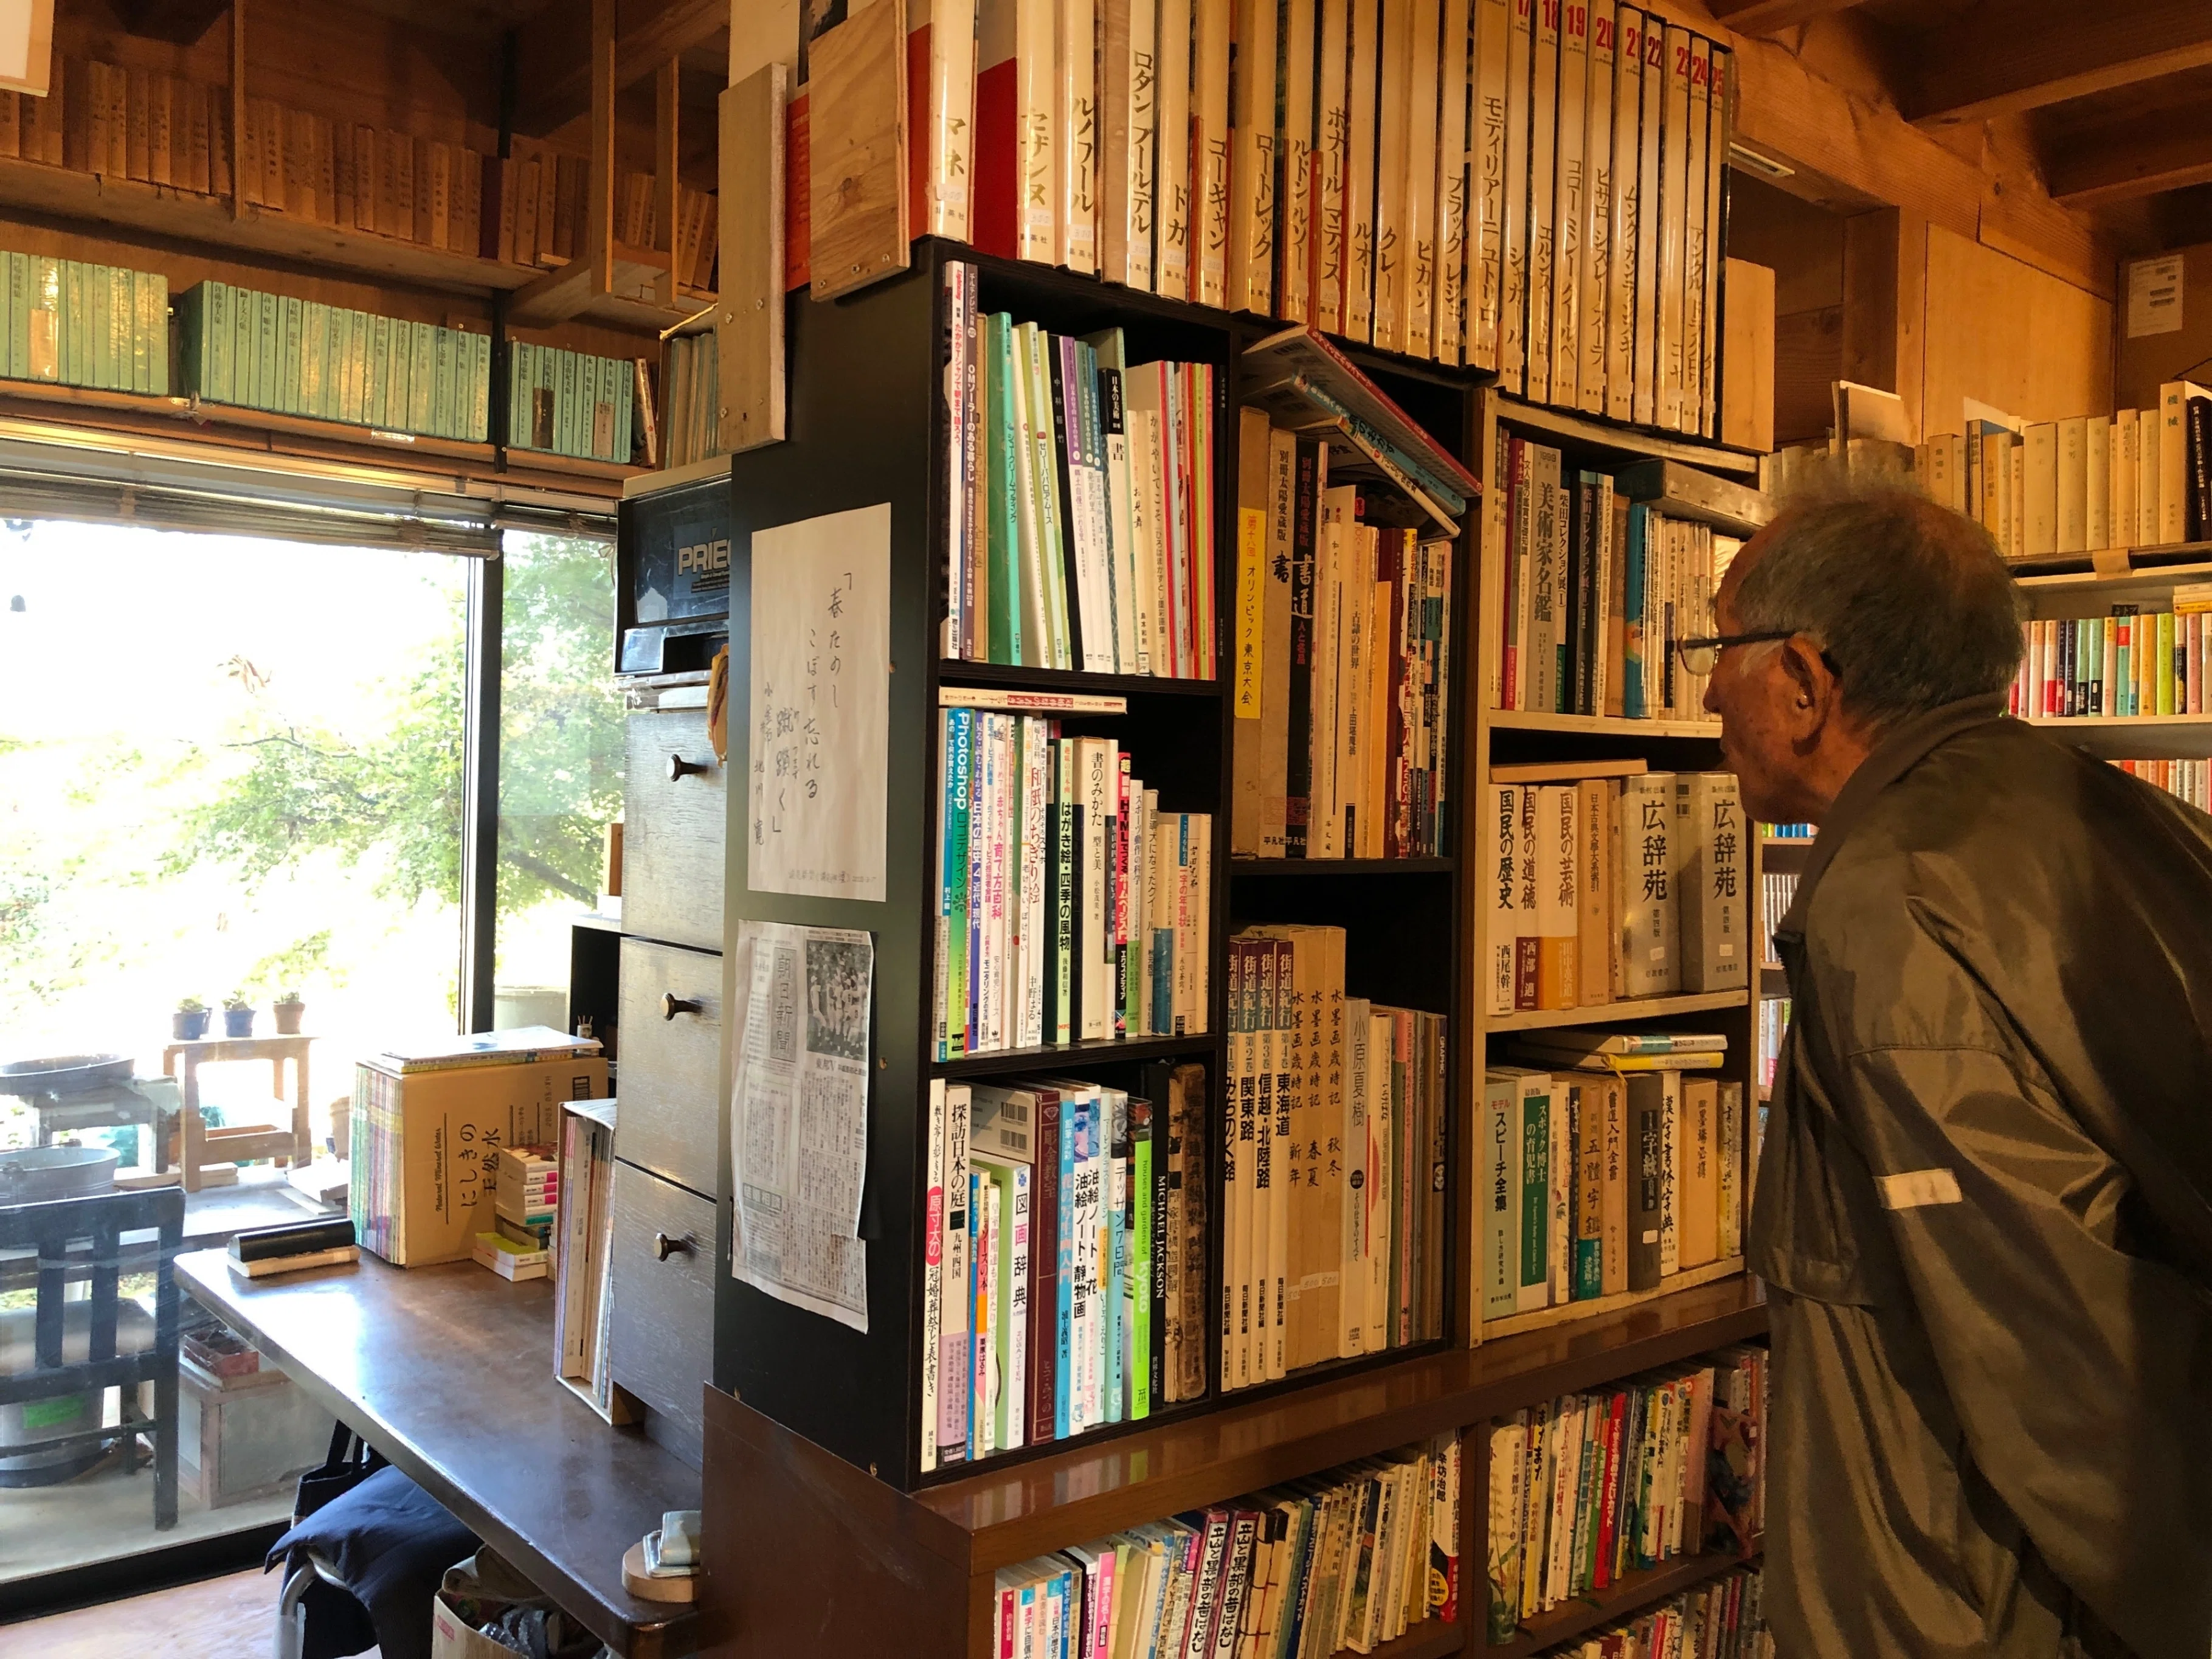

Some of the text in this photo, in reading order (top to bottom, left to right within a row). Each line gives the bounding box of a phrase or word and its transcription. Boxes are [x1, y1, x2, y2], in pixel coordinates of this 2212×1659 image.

[1543, 0, 1557, 32] 18
[1567, 5, 1585, 37] 19
[1596, 17, 1613, 51] 20
[1626, 27, 1640, 59] 21
[1648, 36, 1661, 69] 22
[1693, 55, 1707, 87] 24
[1254, 133, 1273, 260] ロートレック
[1356, 223, 1372, 292] ルオー
[1381, 226, 1397, 297] クレー
[1111, 376, 1120, 419] 日本の美術
[1111, 442, 1124, 461] 書
[1540, 451, 1557, 463] 1999
[1277, 450, 1289, 542] 別冊太陽愛蔵版
[1298, 457, 1312, 547] 別冊太陽愛蔵版
[1271, 550, 1291, 583] 書
[1291, 553, 1315, 619] 書道
[1534, 481, 1555, 622] 美術家名鑑
[953, 711, 970, 810] Photoshop
[1091, 751, 1104, 871] 書のみかた 型と美
[1059, 802, 1072, 952] はがき絵・四季の風物
[1497, 789, 1515, 910] 国民の歴史
[1521, 791, 1536, 910] 国民の道徳
[1558, 792, 1574, 907] 国民の芸術
[1642, 800, 1668, 903] 広辞苑
[1712, 799, 1737, 900] 広辞苑
[1178, 869, 1188, 927] 一字の年賀状
[1243, 955, 1257, 1031] 街道紀行
[1260, 954, 1274, 1031] 街道紀行
[1279, 954, 1293, 1028] 街道紀行
[1501, 943, 1511, 1003] 西尾幹二
[1245, 1035, 1254, 1072] 第2巻
[1262, 1032, 1271, 1070] 第3巻
[1280, 1032, 1290, 1068] 第4巻
[1325, 988, 1343, 1178] 水墨画歳時記 秋冬
[1239, 1076, 1255, 1142] 関東路
[1275, 1073, 1291, 1137] 東海道
[1288, 991, 1305, 1188] 水墨画歳時記 新年
[1305, 989, 1323, 1188] 水墨画歳時記 春夏
[1491, 1098, 1510, 1110] モデル
[459, 1123, 479, 1209] にしきの
[950, 1103, 967, 1208] 探訪日本の庭
[1256, 1073, 1273, 1190] 信越・北陸路
[1494, 1112, 1507, 1212] スピーチ全集
[1526, 1123, 1536, 1185] の育児書
[1537, 1104, 1547, 1183] スポック博士
[927, 1194, 942, 1257] 原寸大の
[951, 1232, 963, 1280] 九州・四国
[1012, 1193, 1028, 1307] 図画辞典
[1073, 1173, 1088, 1319] 油絵ノート・静物画
[1085, 1169, 1100, 1295] 油絵ノート・花
[1113, 1166, 1126, 1277] デッサン7日間
[1141, 1246, 1147, 1255] of
[1155, 1176, 1166, 1299] MICHAEL JACKSON
[1135, 1260, 1150, 1314] kyoto
